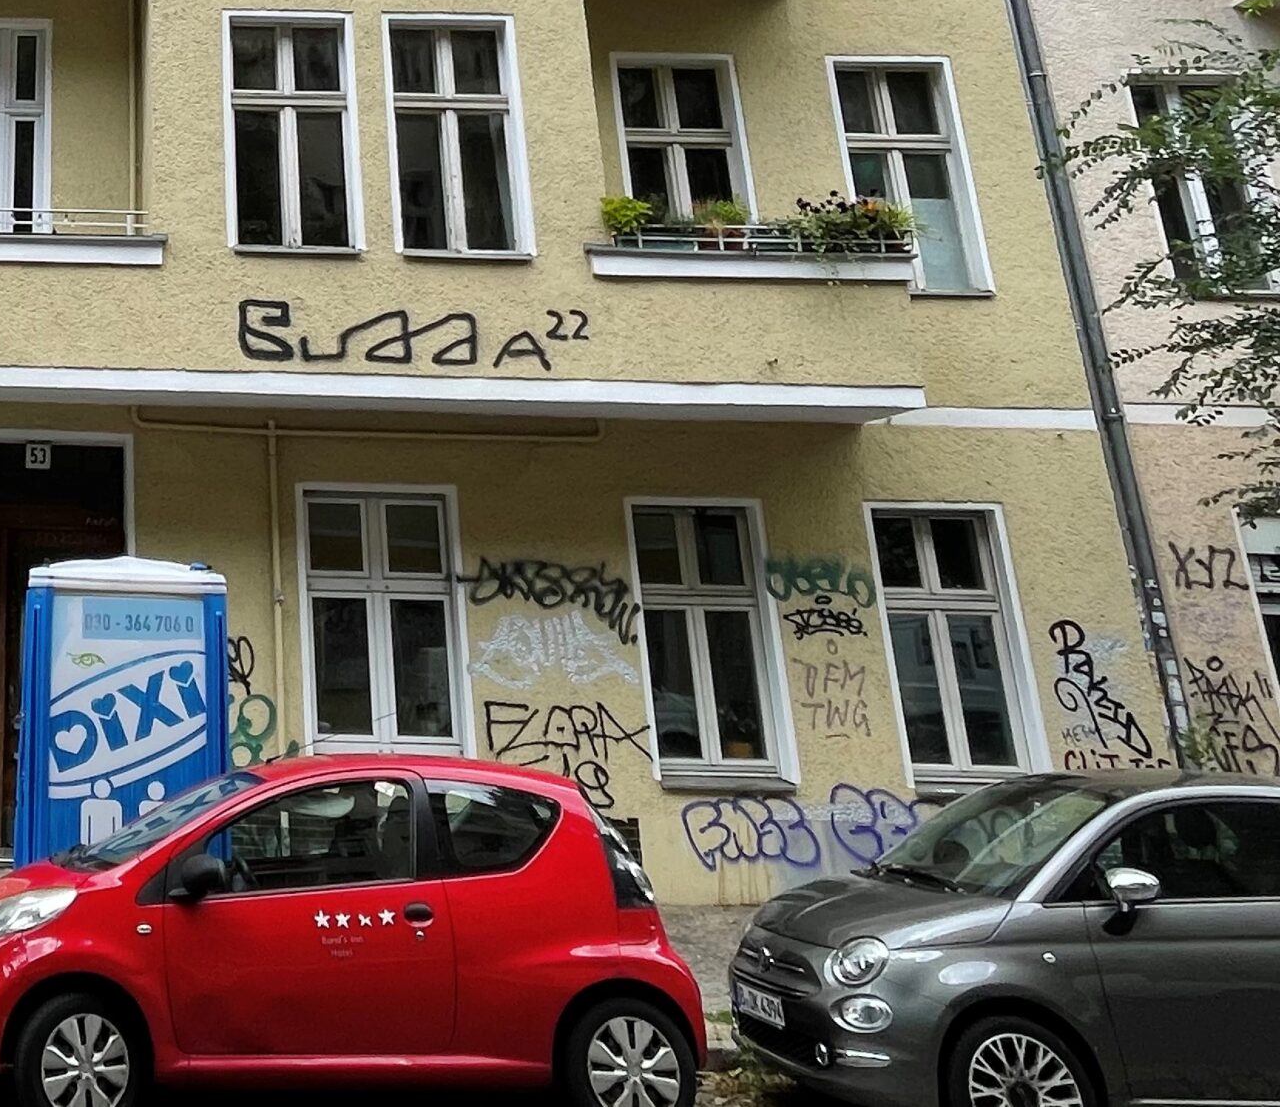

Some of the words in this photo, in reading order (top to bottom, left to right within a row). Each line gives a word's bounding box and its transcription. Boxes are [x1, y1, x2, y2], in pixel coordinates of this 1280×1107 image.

[30, 447, 47, 465] 53
[85, 613, 111, 631] 030
[125, 615, 151, 632] 364
[156, 615, 182, 633] 706
